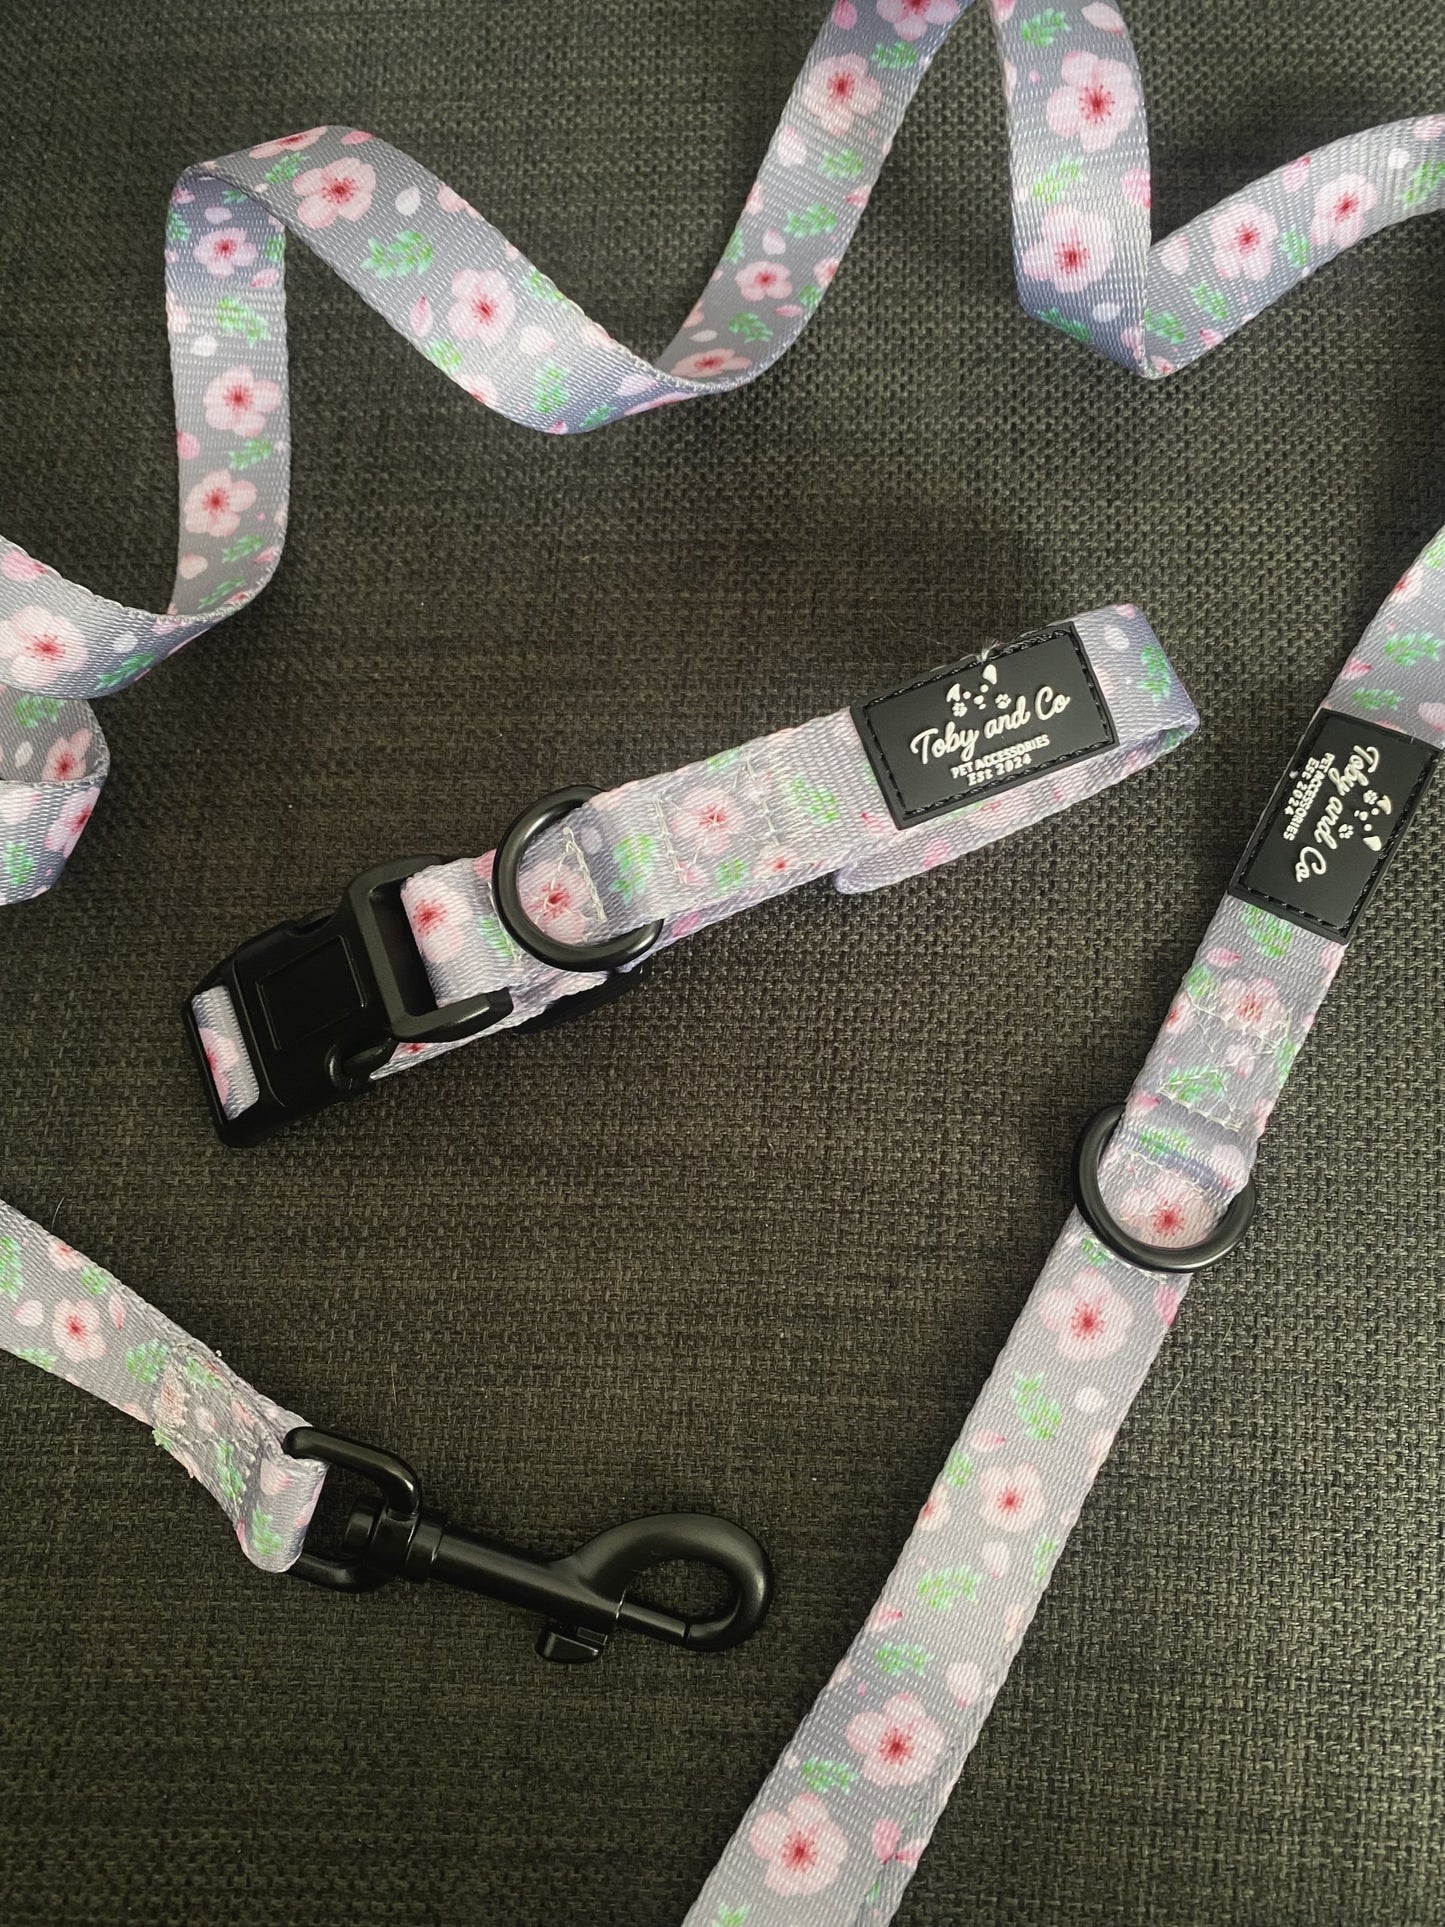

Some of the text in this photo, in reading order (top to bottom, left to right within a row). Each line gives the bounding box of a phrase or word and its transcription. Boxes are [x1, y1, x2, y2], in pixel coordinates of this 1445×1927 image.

[910, 686, 1071, 765] Toby and Co
[950, 735, 1051, 779] PET ACCESSORIES
[995, 754, 1032, 775] 2024
[1283, 752, 1336, 841] PET ACCESSORIES
[1284, 782, 1307, 815] 2024
[1295, 746, 1379, 883] Toby and Co
